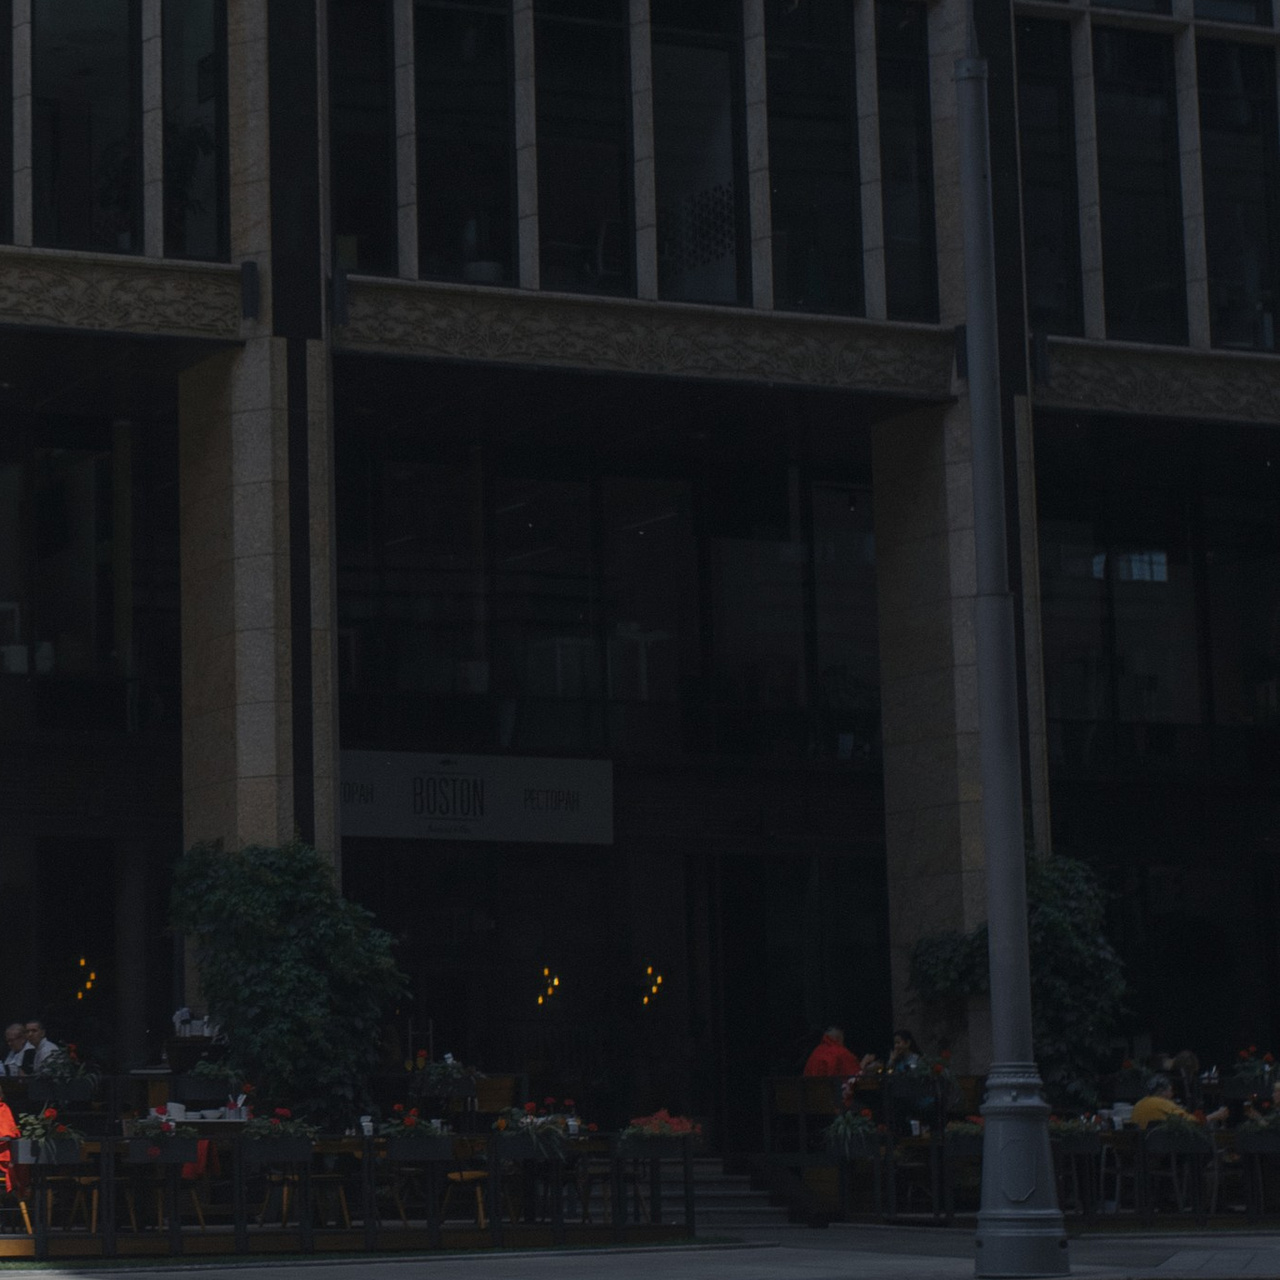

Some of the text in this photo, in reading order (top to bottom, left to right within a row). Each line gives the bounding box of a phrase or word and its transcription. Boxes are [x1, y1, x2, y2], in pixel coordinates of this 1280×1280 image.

[340, 782, 374, 804] ОРАН
[413, 777, 485, 816] BOSTON
[524, 788, 580, 812] РЕСТОРАН
